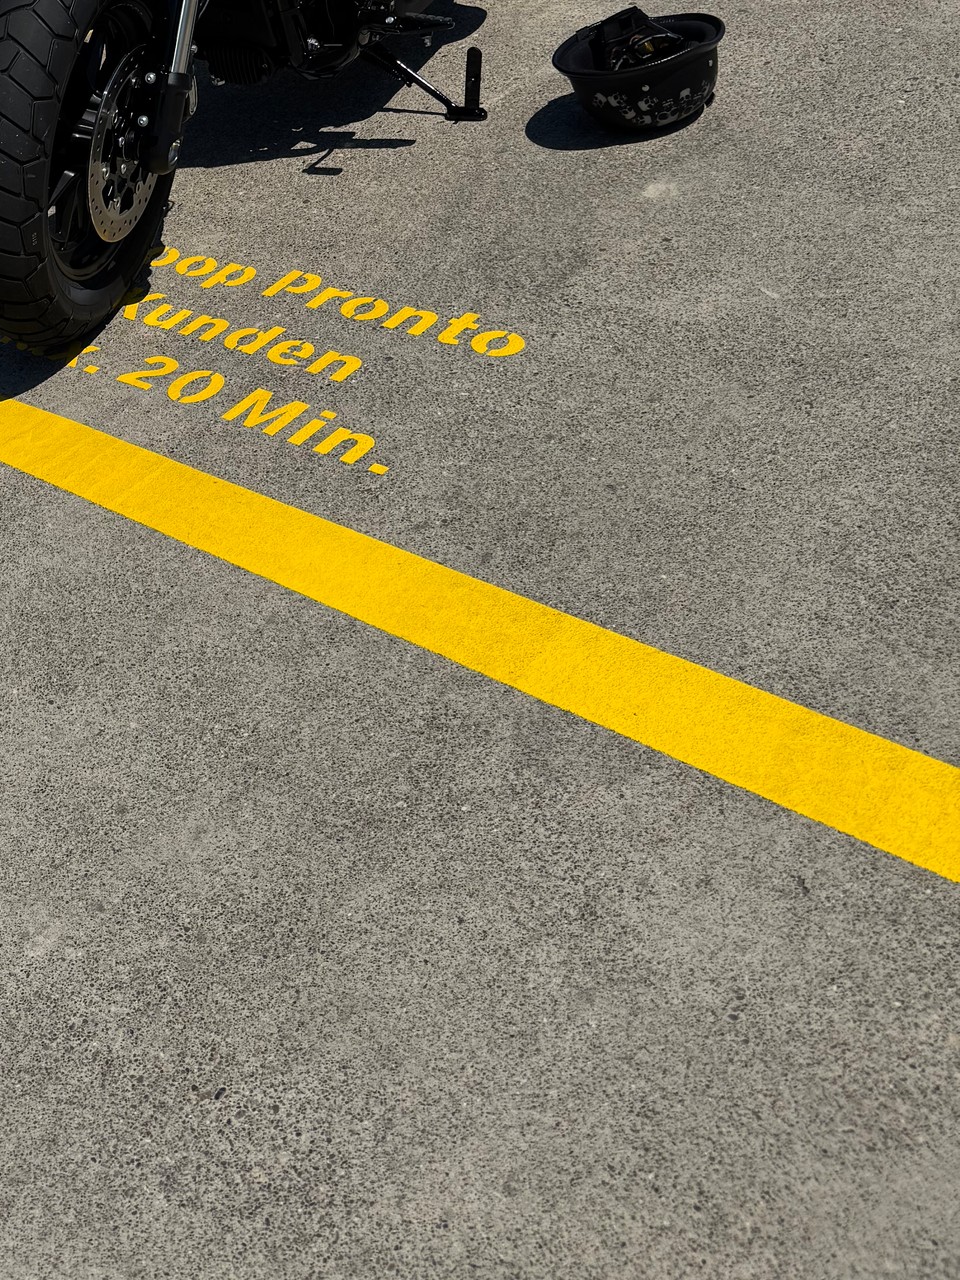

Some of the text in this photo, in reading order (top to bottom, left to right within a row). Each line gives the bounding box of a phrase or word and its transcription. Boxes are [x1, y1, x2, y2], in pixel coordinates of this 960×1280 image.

[122, 288, 363, 383] Kunden
[147, 244, 526, 358] oop Pronto
[116, 354, 226, 405] 20
[222, 389, 390, 476] Min.
